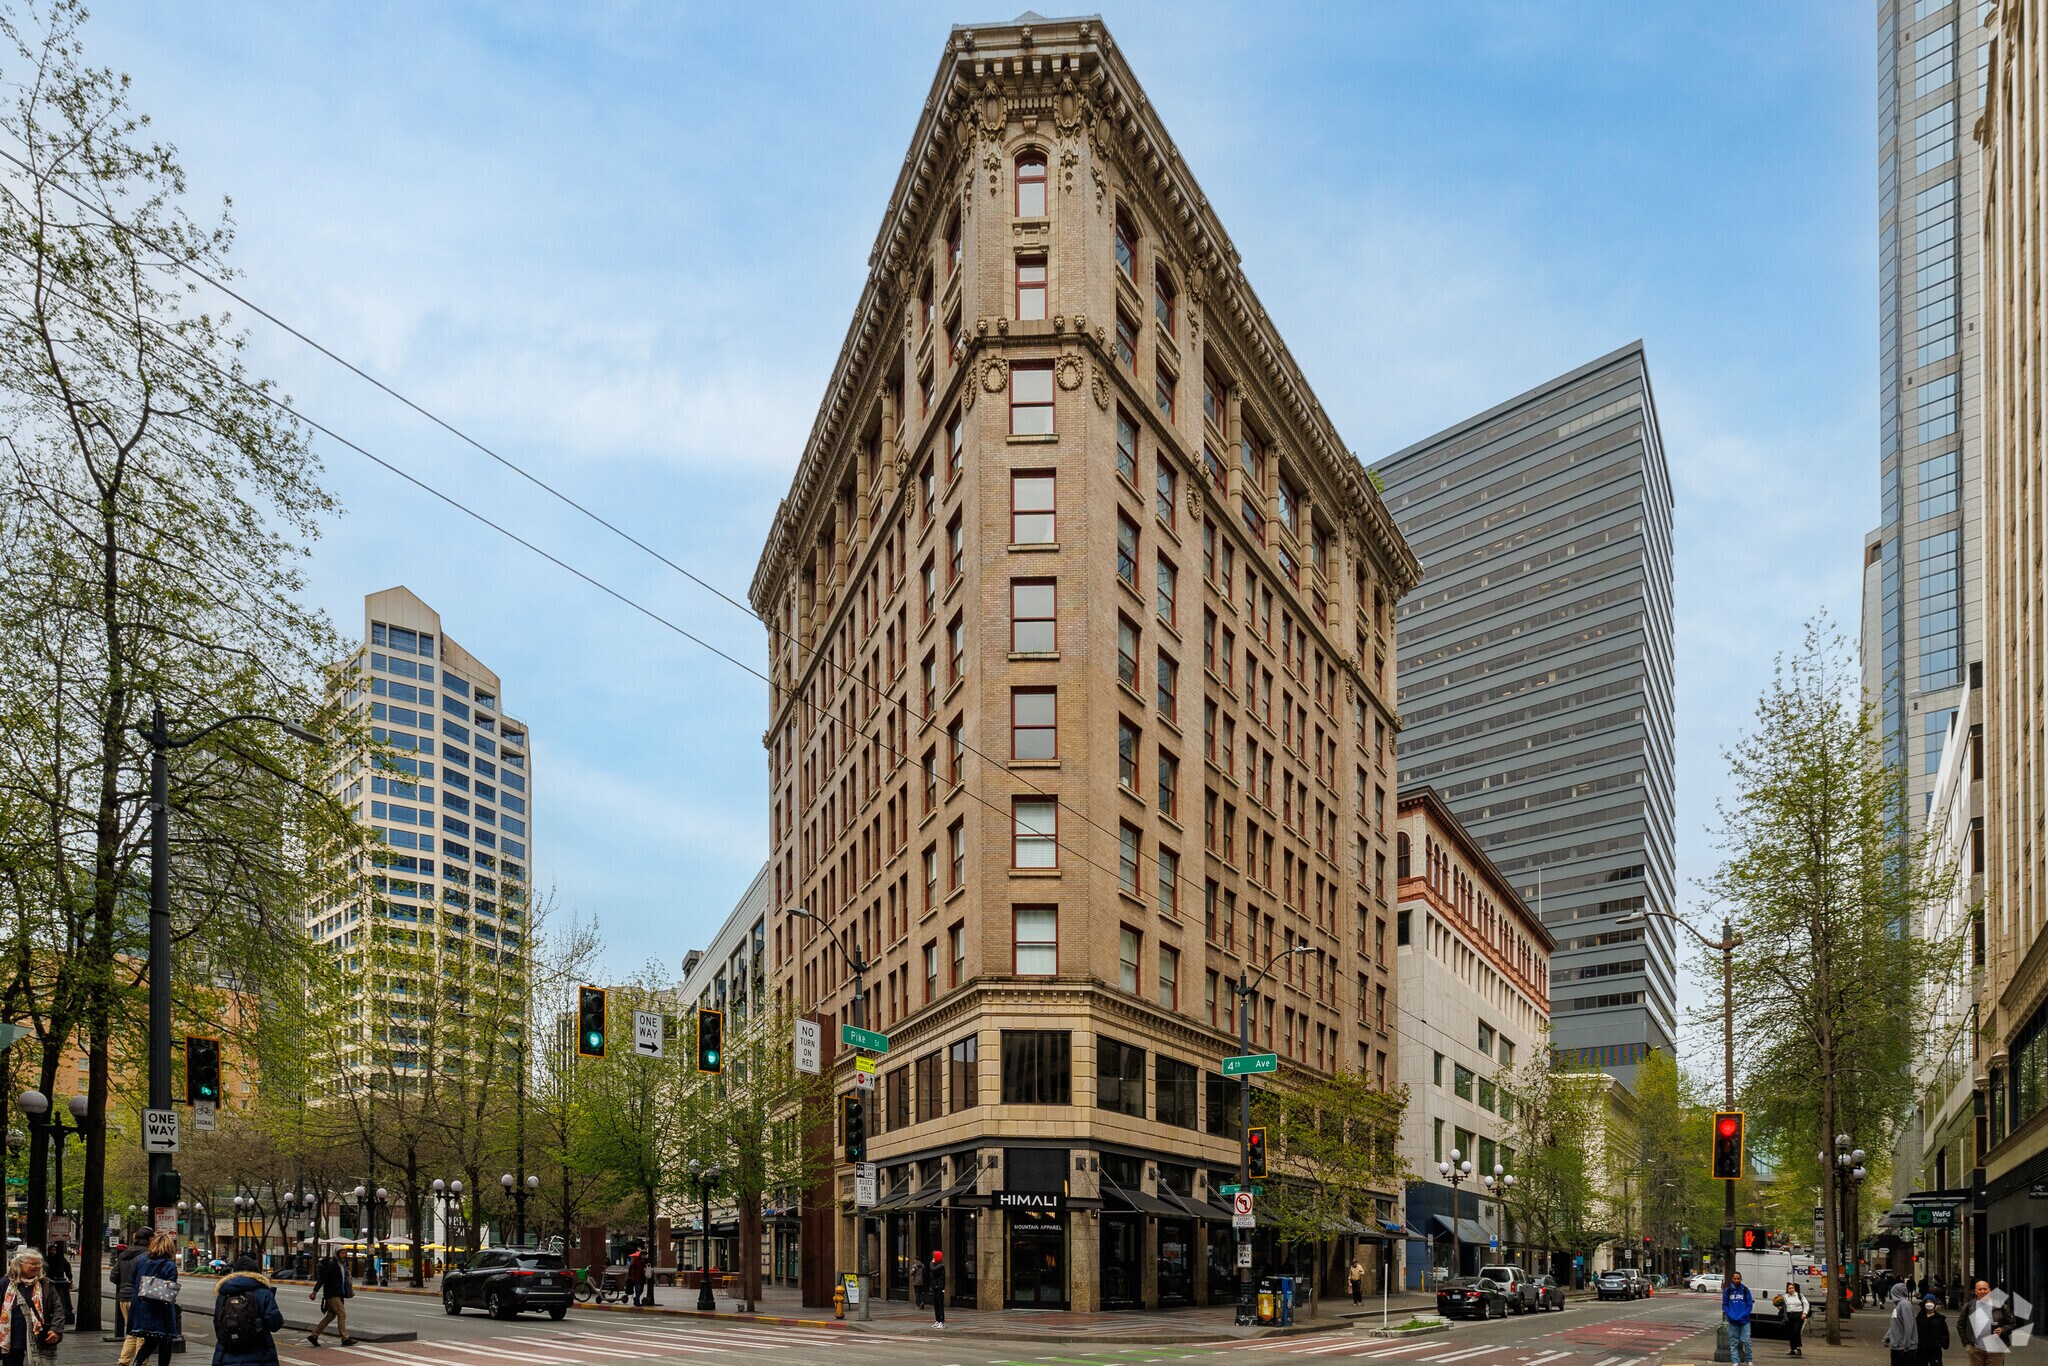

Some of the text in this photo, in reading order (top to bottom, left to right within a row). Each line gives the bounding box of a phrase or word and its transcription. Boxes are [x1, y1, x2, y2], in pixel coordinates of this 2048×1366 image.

[640, 1015, 657, 1028] ONE
[639, 1027, 659, 1040] WAY
[802, 1025, 814, 1038] NO
[800, 1037, 816, 1048] TURN
[851, 1031, 880, 1048] Pike St
[804, 1048, 812, 1057] ON
[802, 1058, 814, 1068] RED
[1228, 1060, 1270, 1071] 4th Ave
[148, 1113, 175, 1124] ONE
[149, 1125, 176, 1136] WAY
[1000, 1195, 1057, 1206] HIMALI
[1932, 1210, 1951, 1218] WaFd
[1792, 1265, 1822, 1275] FedEx
